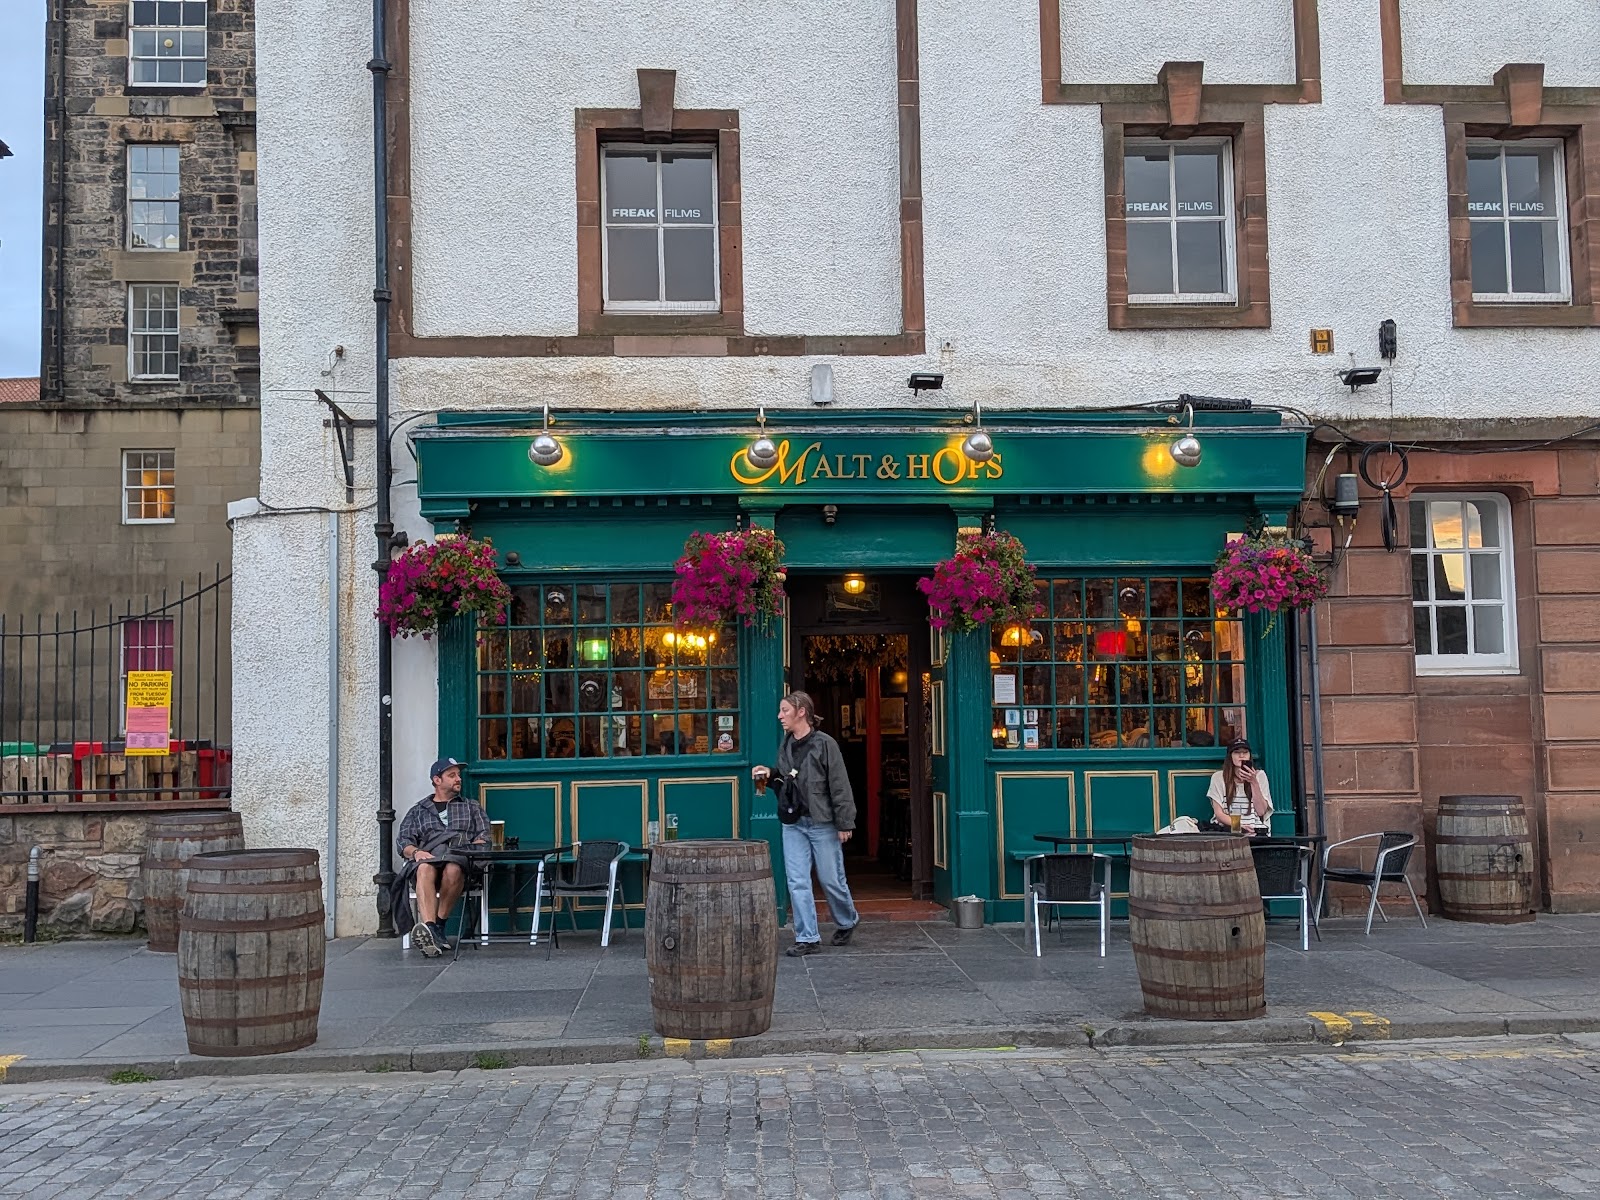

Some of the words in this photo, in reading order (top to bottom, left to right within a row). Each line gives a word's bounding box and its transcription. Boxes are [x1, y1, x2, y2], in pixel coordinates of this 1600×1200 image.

[1126, 203, 1168, 211] FREAK
[1178, 202, 1213, 211] FILMS
[1468, 202, 1502, 211] REAK
[1510, 202, 1544, 211] FILMS
[612, 208, 656, 218] FREAK
[664, 209, 701, 218] FILMS
[876, 454, 900, 479] &
